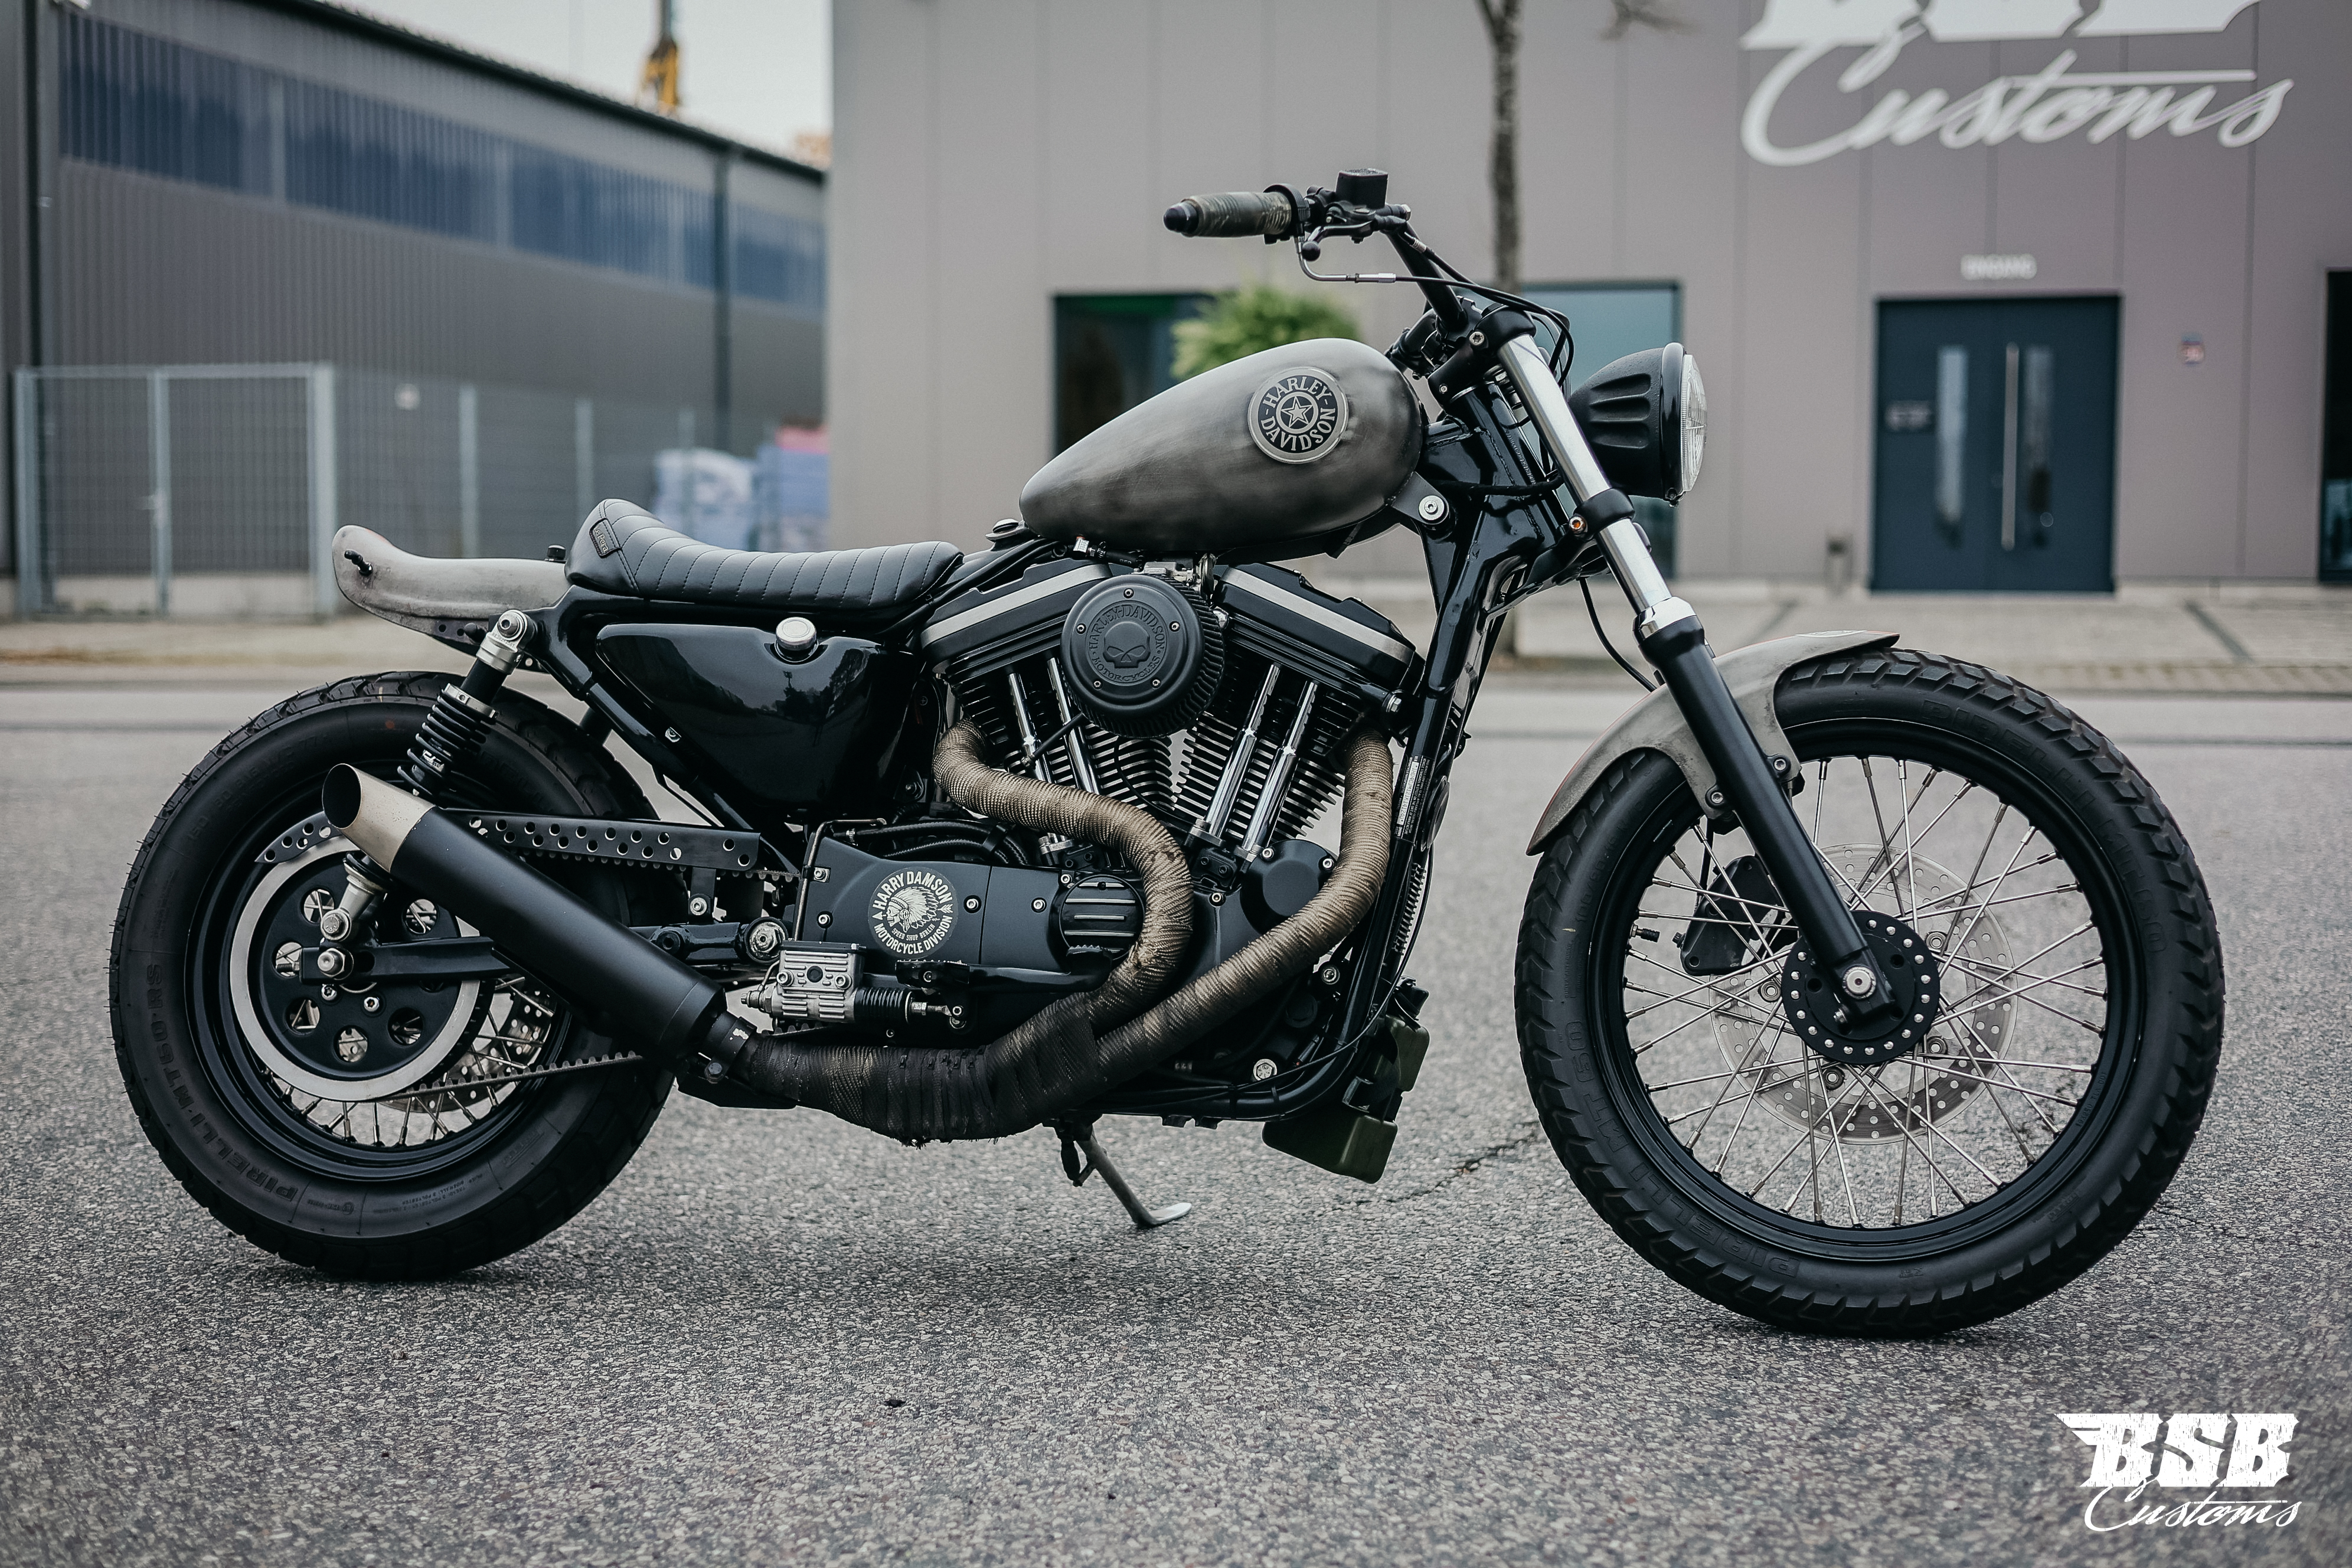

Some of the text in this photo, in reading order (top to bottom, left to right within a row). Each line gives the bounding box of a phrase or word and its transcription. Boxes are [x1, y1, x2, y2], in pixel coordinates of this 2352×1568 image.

[1740, 18, 2295, 166] Customs
[1092, 655, 1161, 682] MOTORCYCLES
[872, 871, 953, 910] HARRY DAMSON
[873, 916, 953, 955] MOTORCYCLE DIVISION
[891, 927, 906, 940] SPEED
[919, 923, 936, 939] BERLIN
[188, 1111, 299, 1203] PIRELLI
[1562, 1019, 1801, 1279] PIRELLI MT 60
